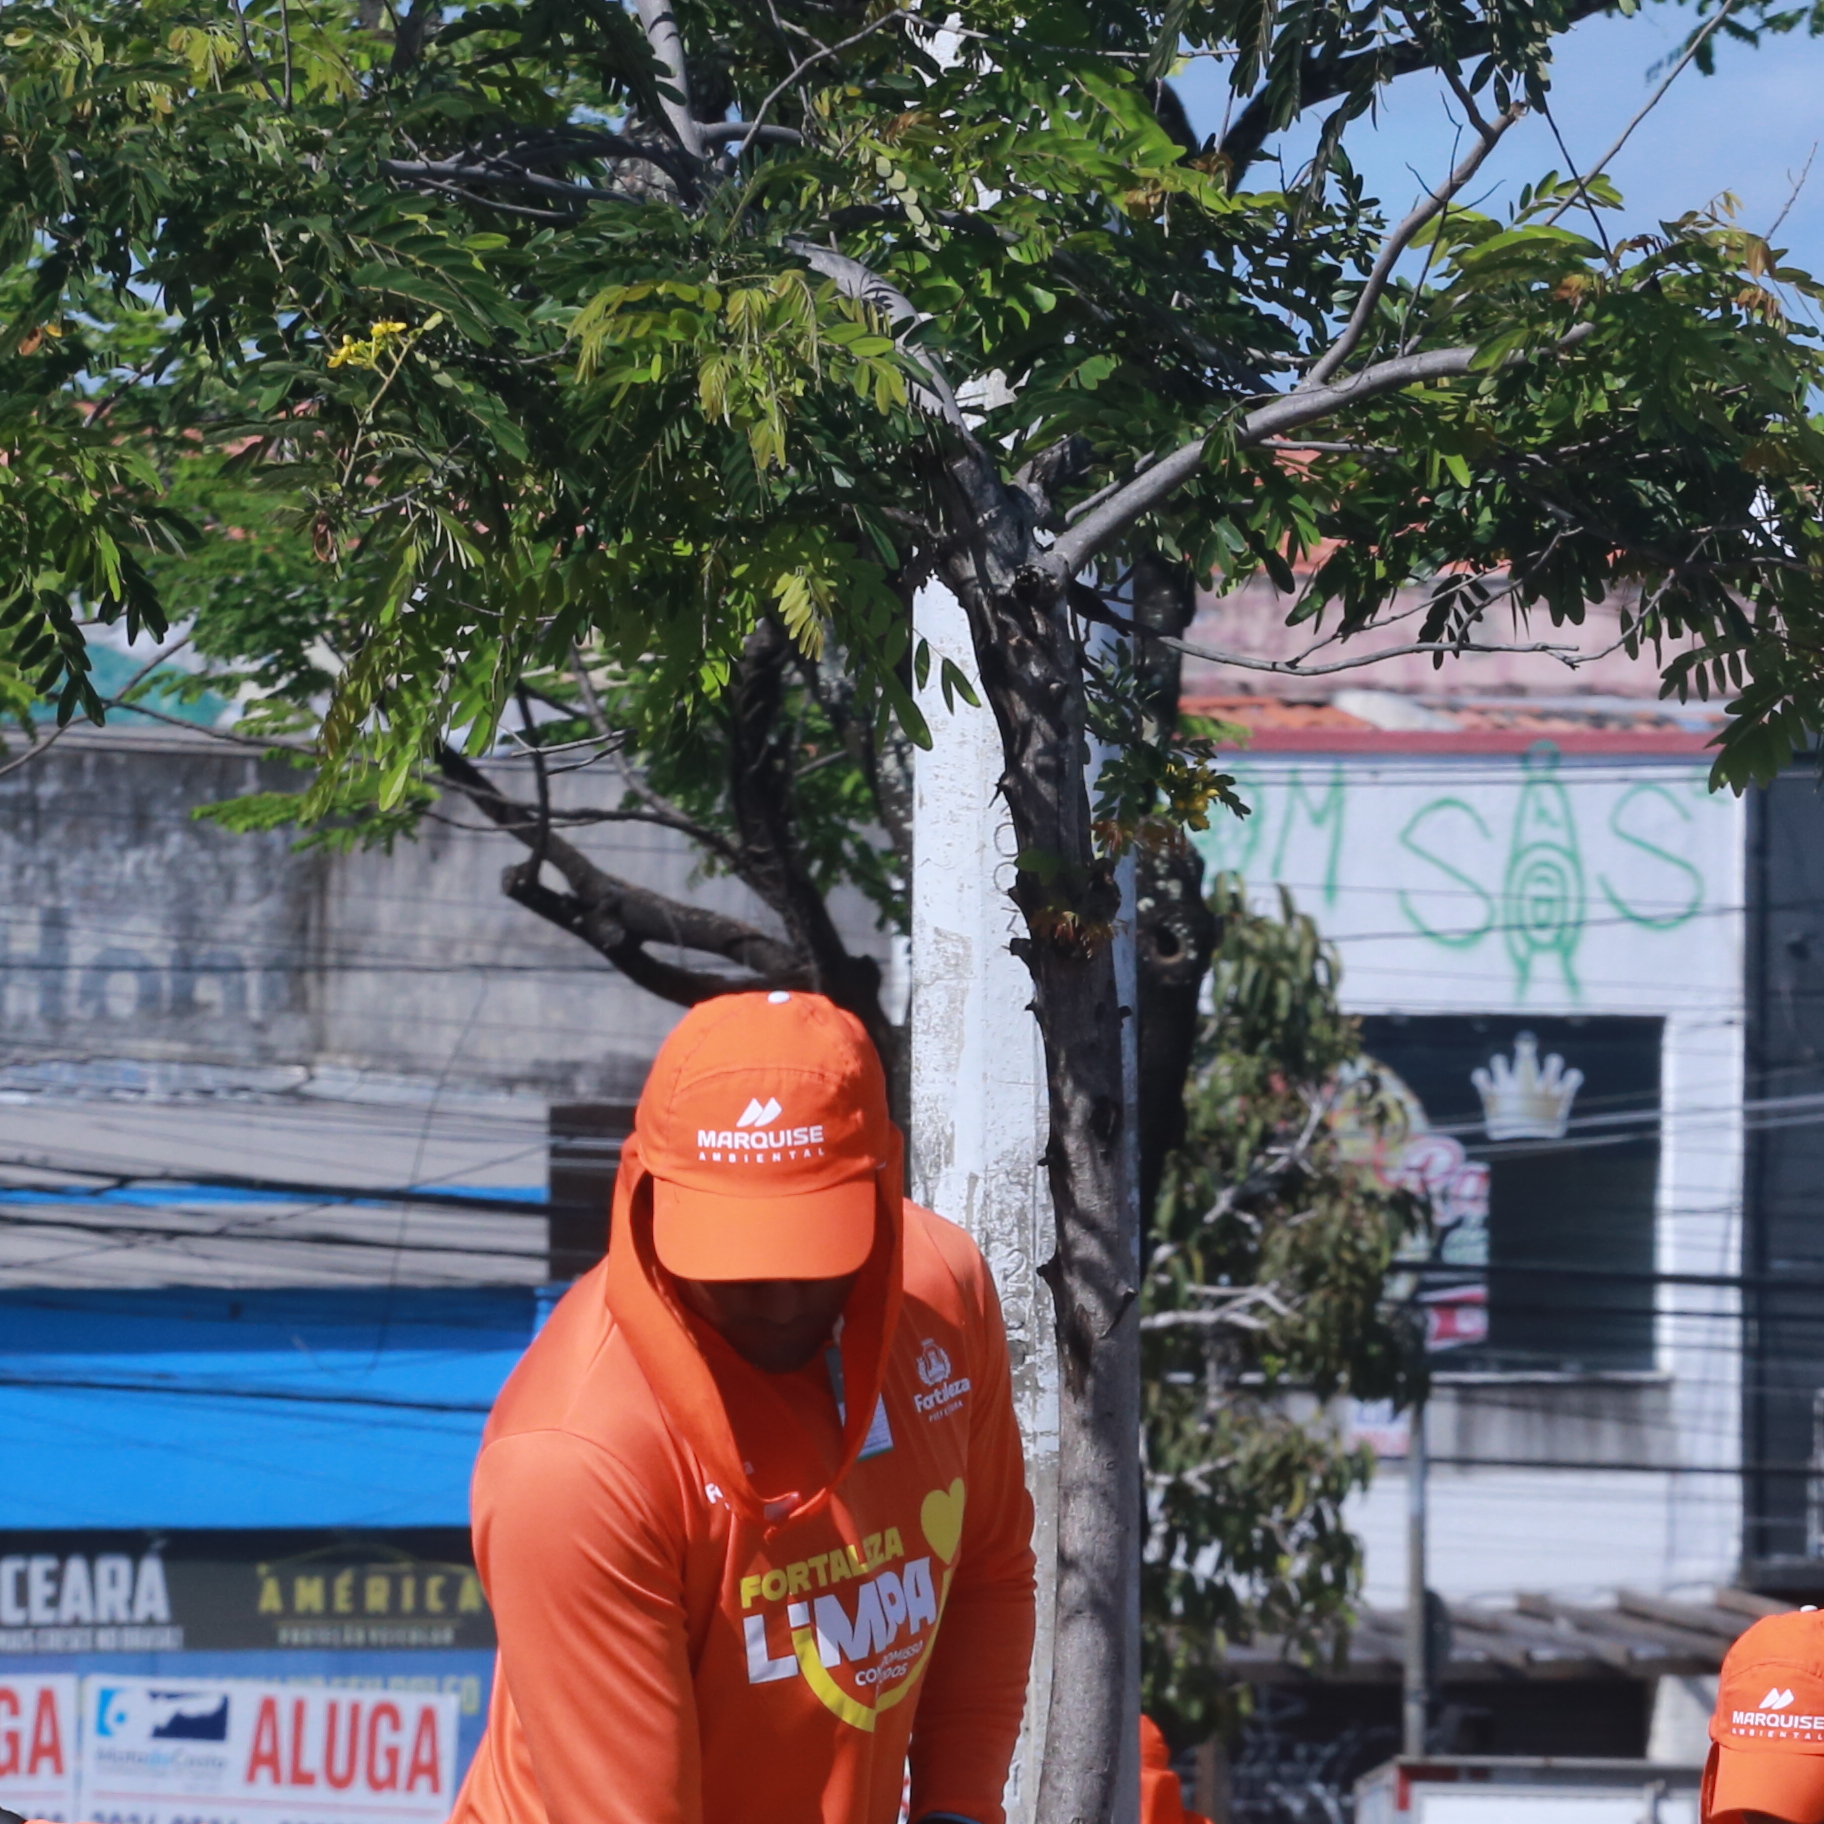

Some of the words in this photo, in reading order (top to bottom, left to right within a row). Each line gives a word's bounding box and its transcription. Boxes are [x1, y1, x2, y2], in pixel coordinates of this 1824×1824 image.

[696, 1124, 824, 1149] MARQUISE
[698, 1147, 825, 1164] AMBIENTAL
[257, 1567, 483, 1613] AMÉRICA
[246, 1695, 441, 1795] ALUGA
